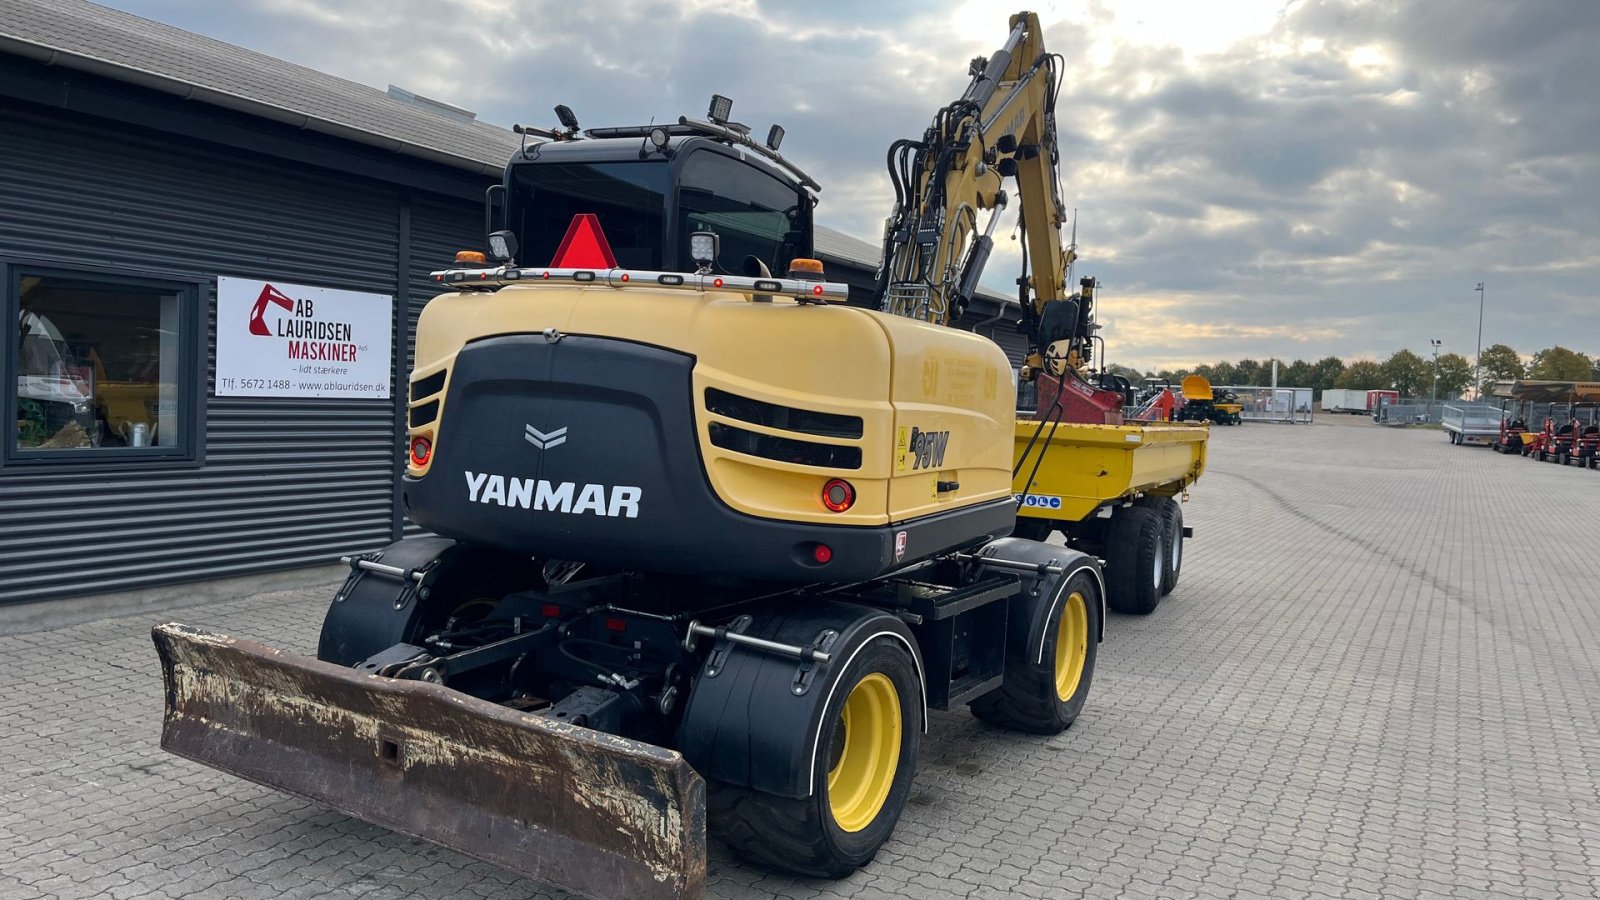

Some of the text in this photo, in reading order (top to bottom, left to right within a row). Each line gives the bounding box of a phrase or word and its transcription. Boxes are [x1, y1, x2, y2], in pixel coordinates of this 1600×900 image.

[296, 299, 313, 318] AB
[278, 318, 352, 342] LAURIDSEN
[288, 340, 357, 362] MASKINER
[299, 364, 312, 374] lidt
[313, 366, 348, 375] stærkere
[222, 378, 238, 390] Tlf.
[240, 379, 265, 389] 5672
[267, 379, 291, 390] 1488
[299, 381, 386, 392] www.ablauridsen.dk
[464, 471, 642, 518] YANMAR
